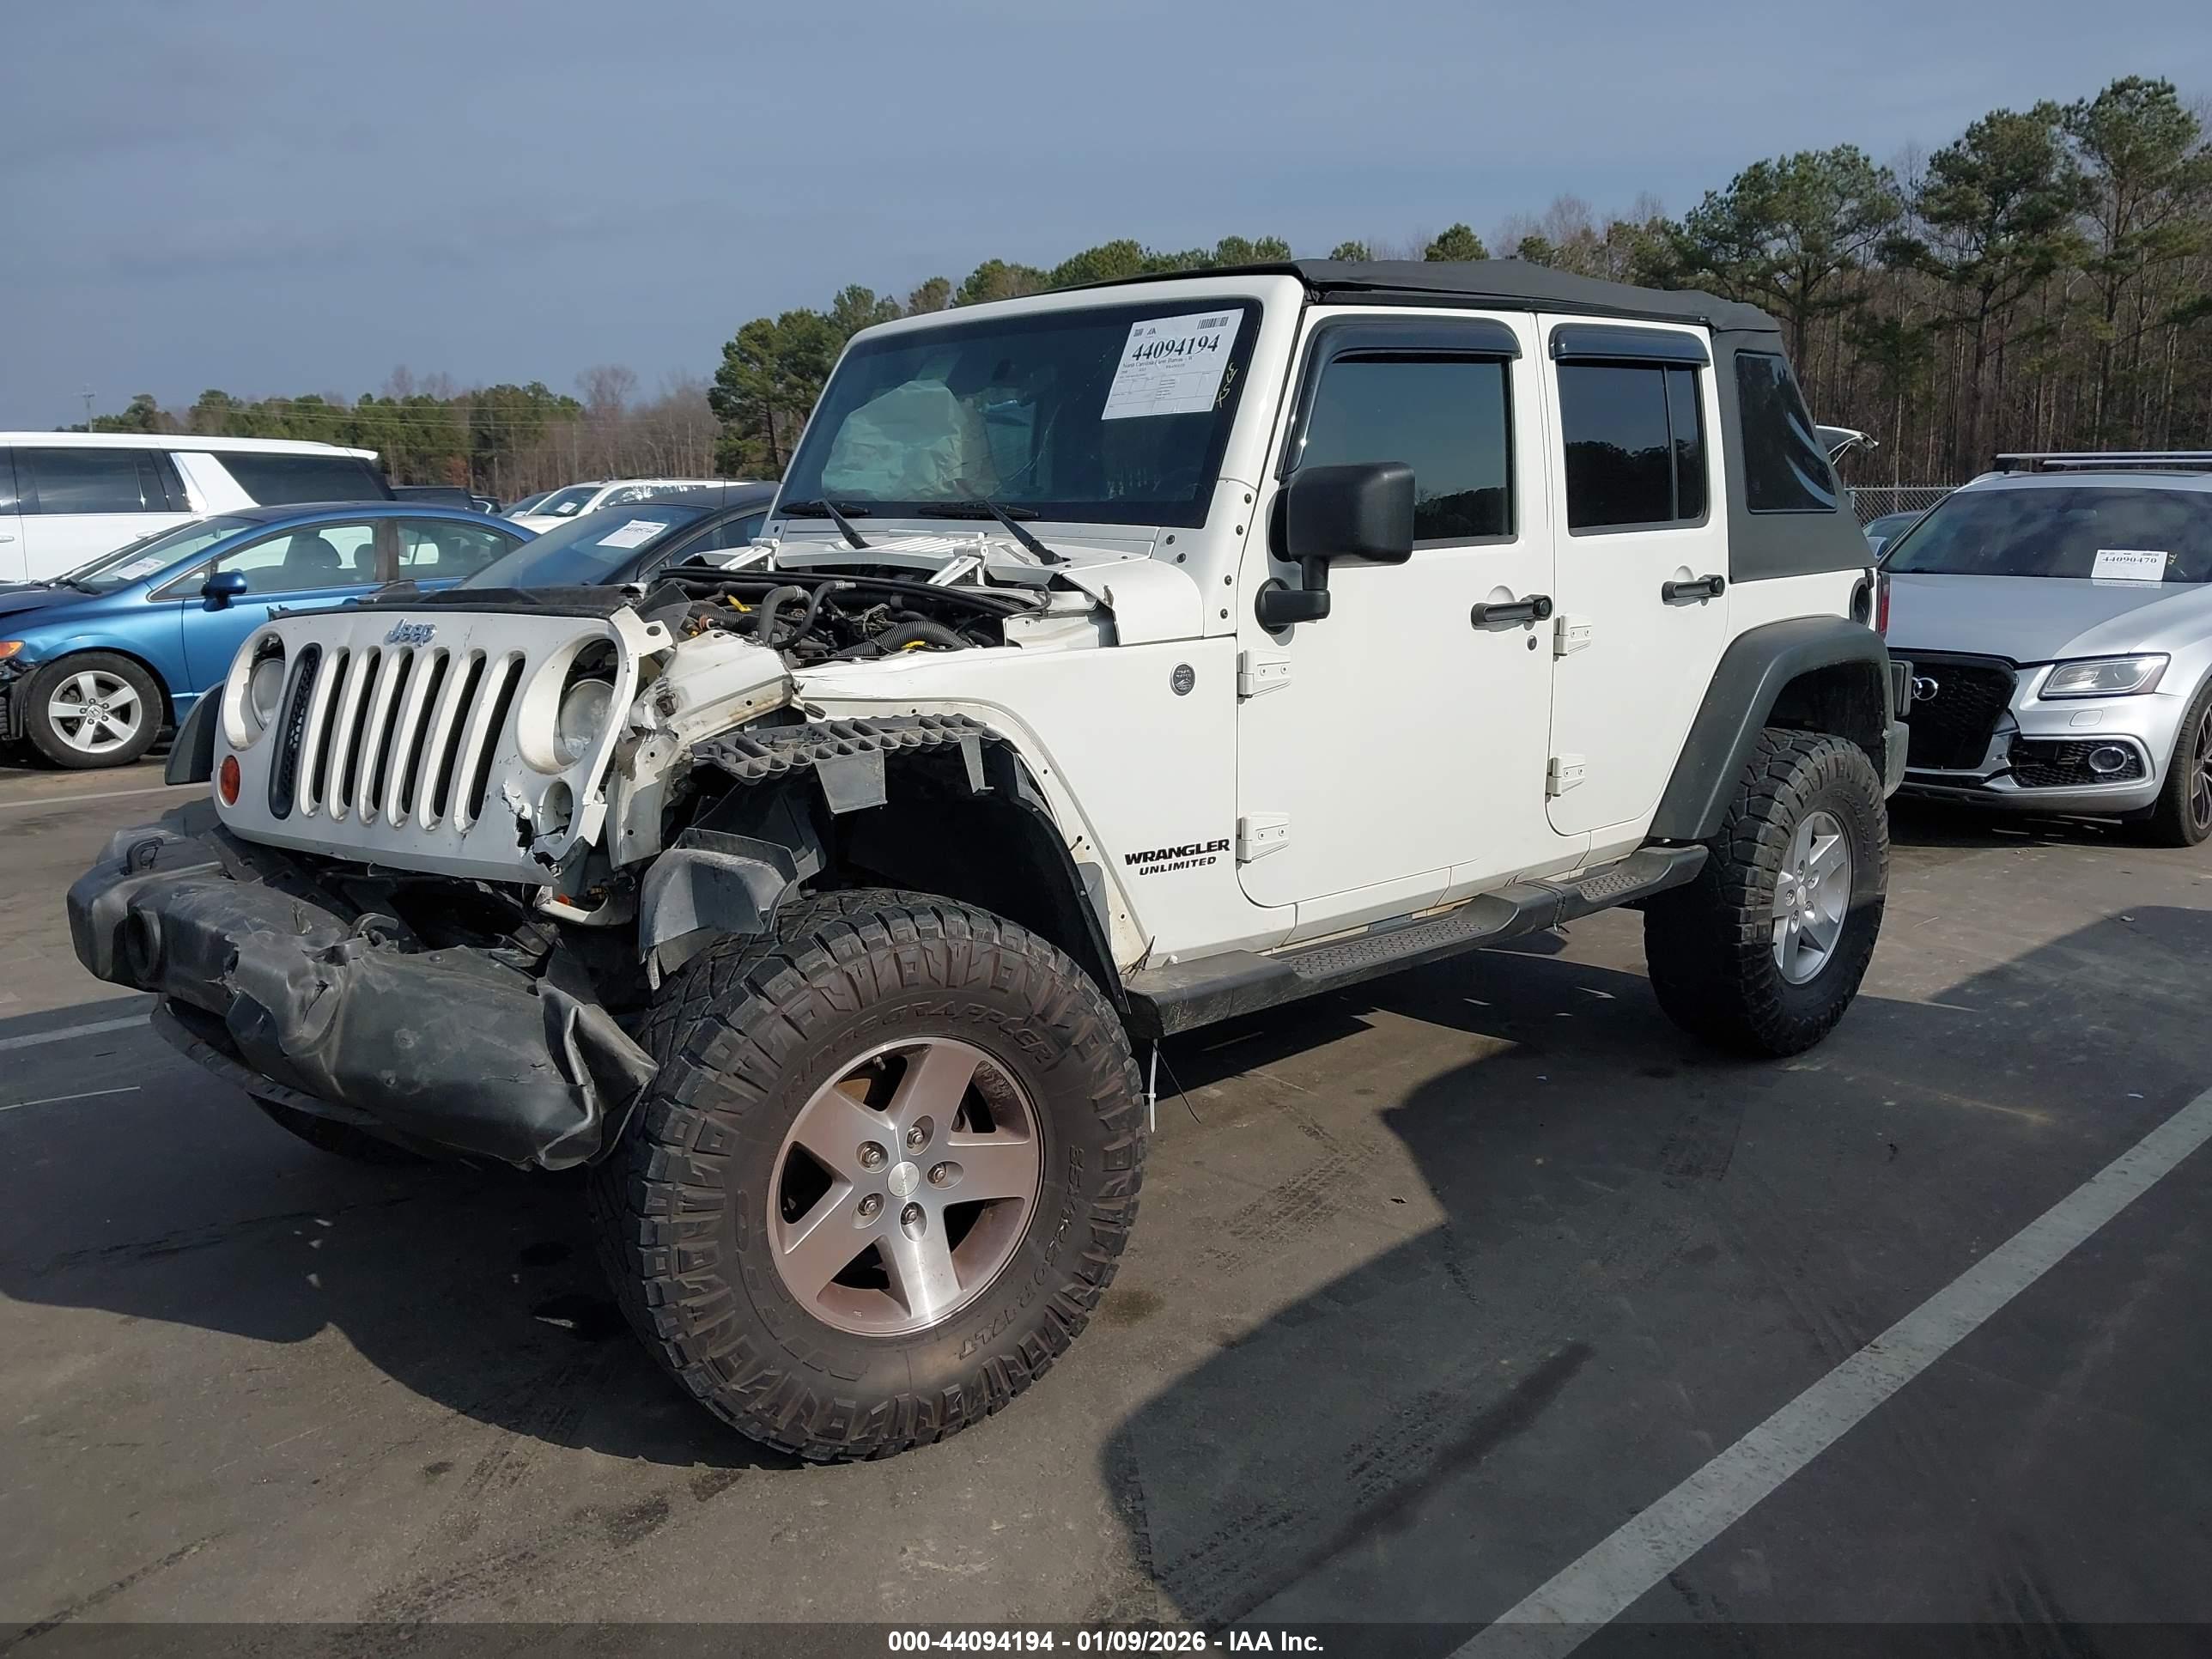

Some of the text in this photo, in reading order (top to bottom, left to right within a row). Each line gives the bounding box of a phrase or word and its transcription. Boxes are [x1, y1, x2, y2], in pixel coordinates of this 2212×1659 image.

[1132, 334, 1220, 361] 44094194
[384, 618, 436, 648] Jeep
[1124, 839, 1231, 866] WRANGLER
[1139, 856, 1217, 876] UNLIMITED
